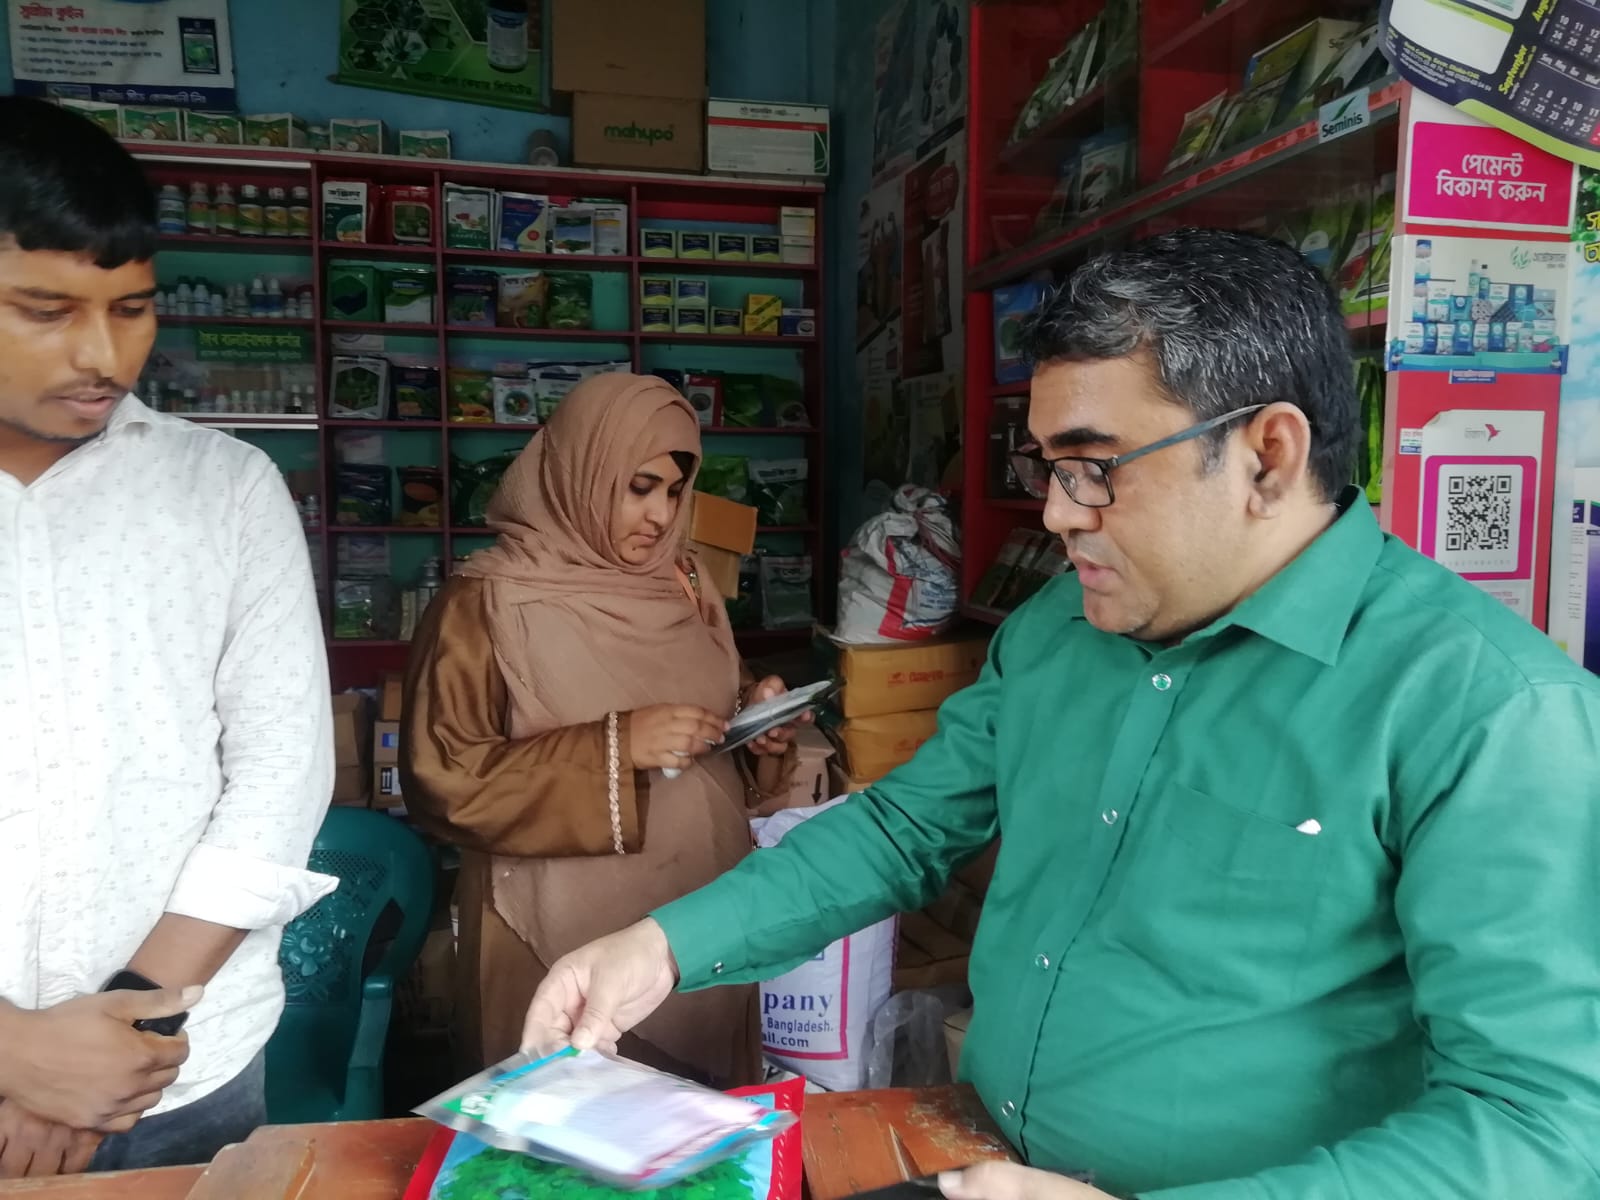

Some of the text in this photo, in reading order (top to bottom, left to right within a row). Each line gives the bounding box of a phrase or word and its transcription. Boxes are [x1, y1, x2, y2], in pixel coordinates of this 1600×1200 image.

[1560, 15, 1600, 39] 10 11 12
[1552, 30, 1593, 54] 24 25 26
[1498, 43, 1528, 95] September
[1532, 82, 1540, 91] 7
[1546, 89, 1554, 99] 8
[1560, 96, 1568, 105] 9
[1572, 101, 1583, 112] 10
[1588, 107, 1600, 118] 11
[1321, 112, 1364, 137] Seminis
[1519, 96, 1593, 133] 21 22 23 24 25
[1461, 152, 1524, 177] পেমেন্ট
[1435, 168, 1547, 202] বিকাশ করুন
[763, 992, 832, 1018] pany
[767, 1016, 834, 1034] Bangladesh.
[761, 1031, 809, 1048] ail.com
